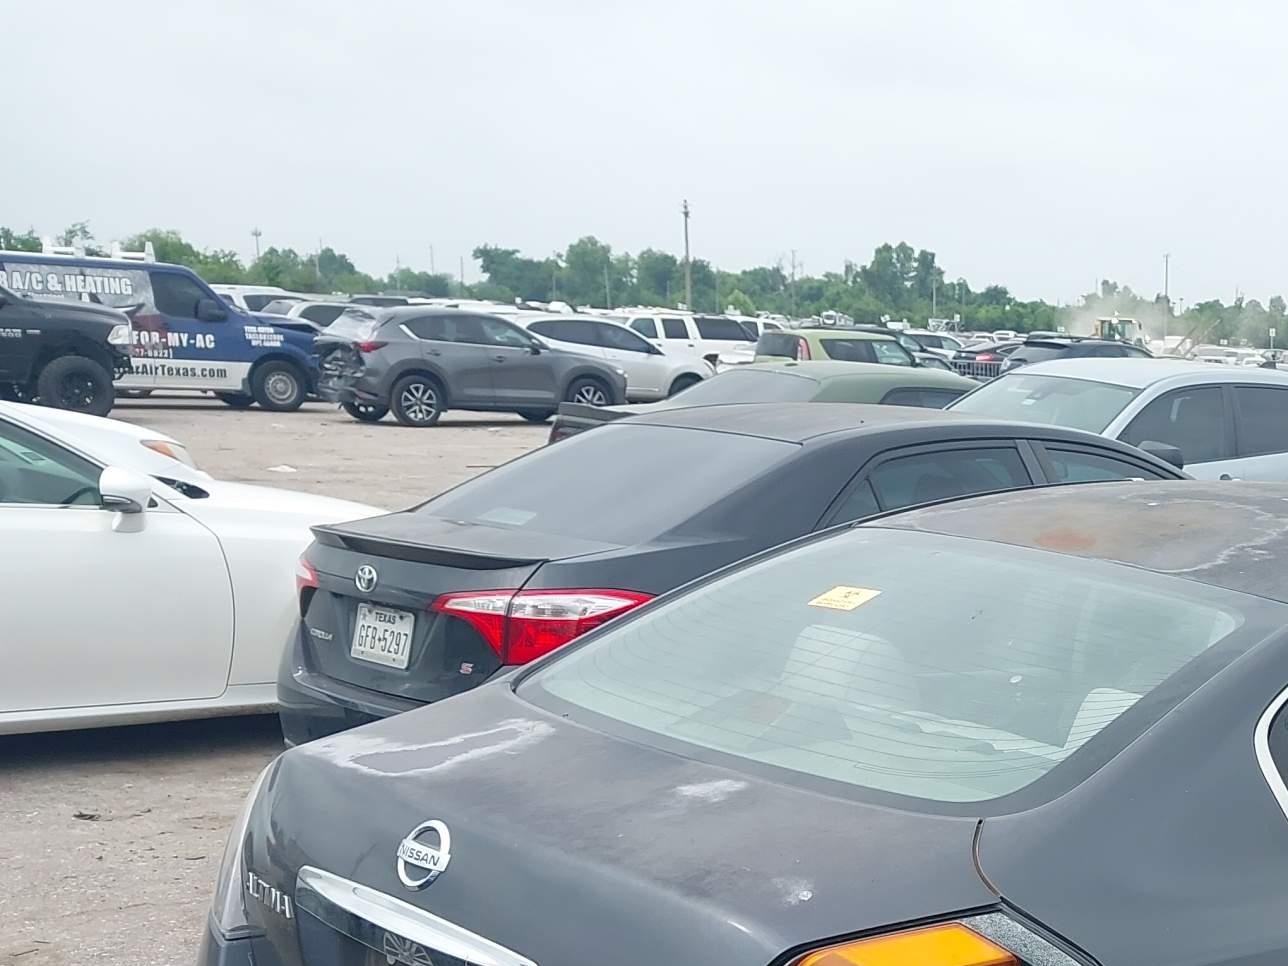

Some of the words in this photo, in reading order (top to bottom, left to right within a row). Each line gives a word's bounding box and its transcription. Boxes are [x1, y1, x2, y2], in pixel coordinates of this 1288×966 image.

[12, 271, 43, 291] A/C
[47, 273, 62, 294] &
[64, 274, 133, 295] HEATING
[375, 611, 396, 625] TEXAS
[400, 843, 440, 867] NISSAN
